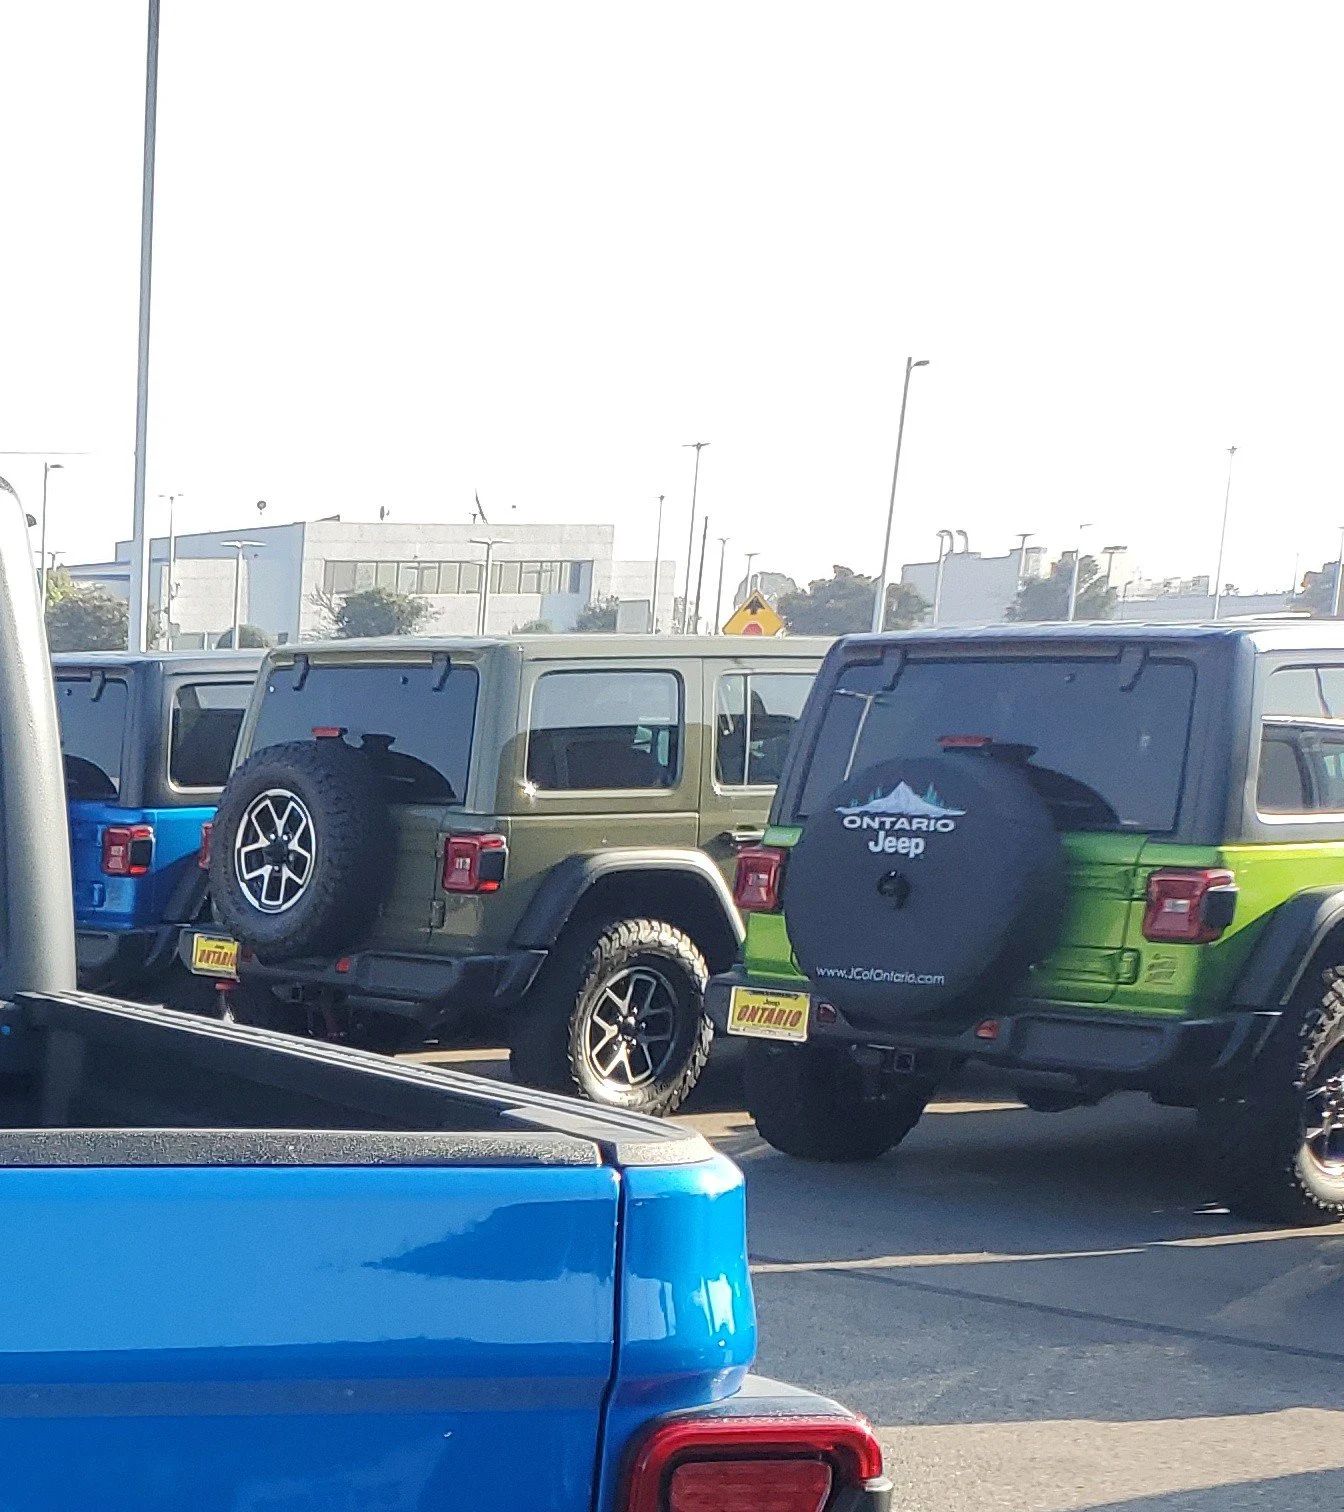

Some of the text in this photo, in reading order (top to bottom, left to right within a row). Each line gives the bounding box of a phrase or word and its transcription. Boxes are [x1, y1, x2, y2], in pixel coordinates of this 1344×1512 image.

[843, 816, 955, 832] ONTARIO
[868, 831, 925, 858] Jeep
[737, 1005, 802, 1027] ONTARIO
